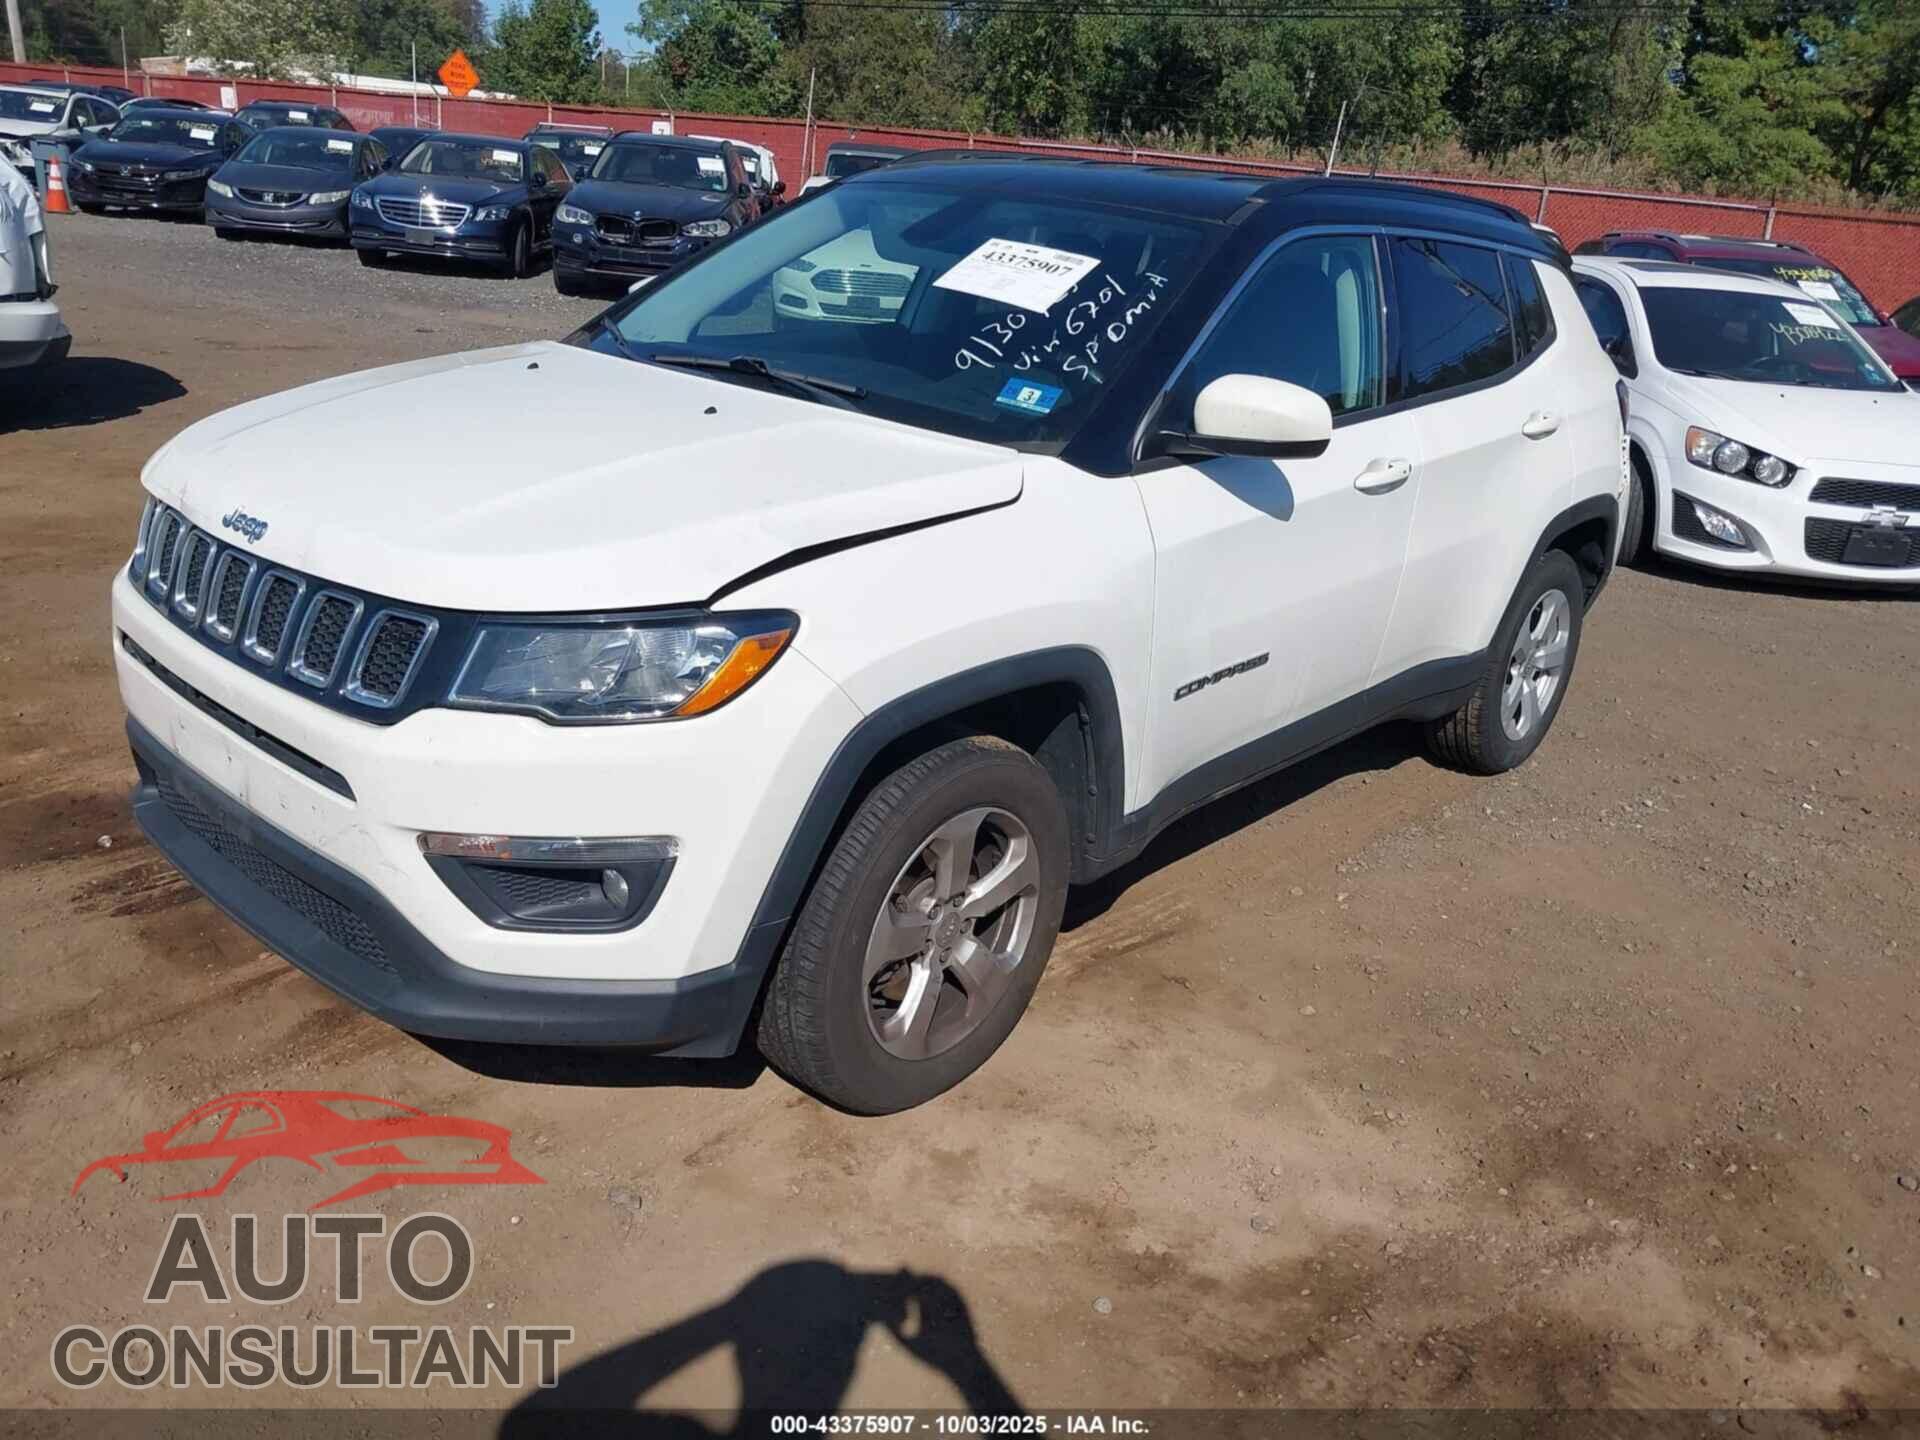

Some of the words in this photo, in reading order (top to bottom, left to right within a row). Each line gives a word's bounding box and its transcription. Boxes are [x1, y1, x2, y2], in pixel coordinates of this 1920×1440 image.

[982, 250, 1073, 277] 43375907
[222, 508, 268, 544] Jeep
[1174, 652, 1269, 701] COMPASS
